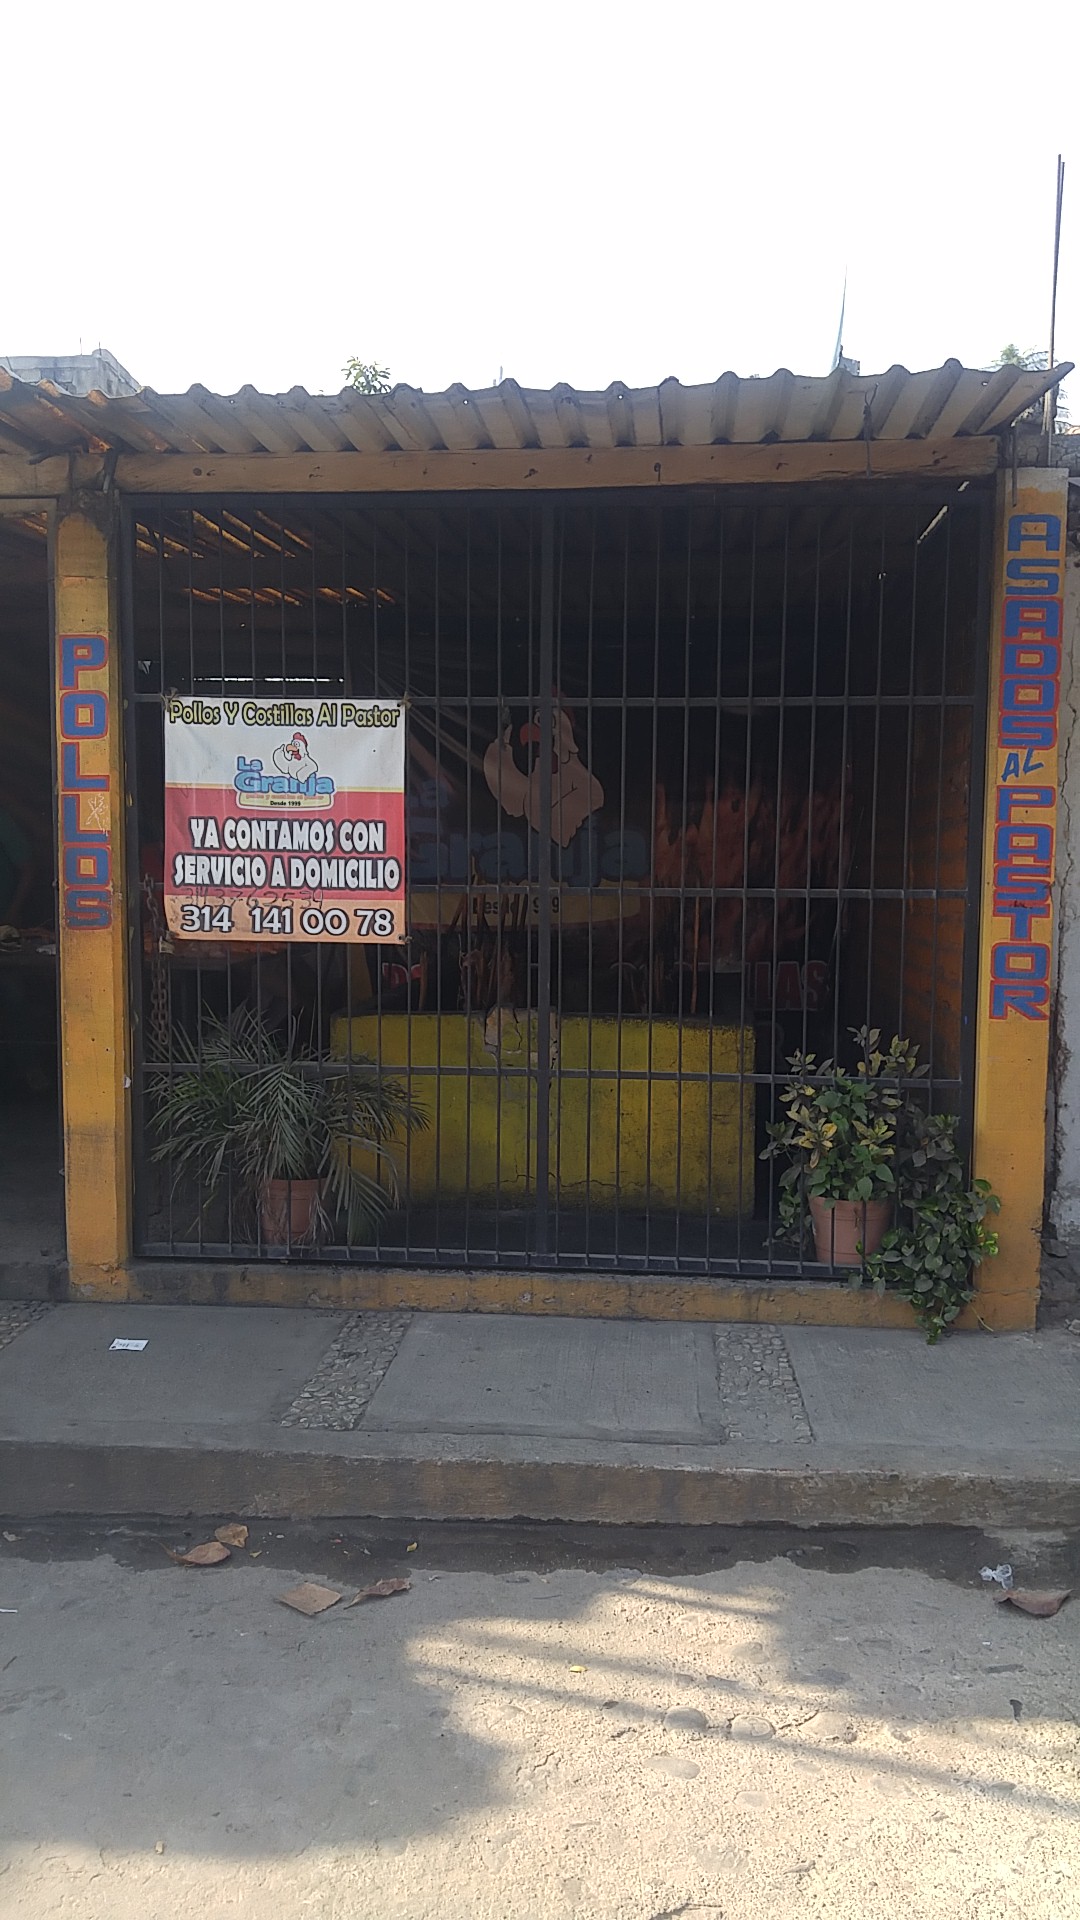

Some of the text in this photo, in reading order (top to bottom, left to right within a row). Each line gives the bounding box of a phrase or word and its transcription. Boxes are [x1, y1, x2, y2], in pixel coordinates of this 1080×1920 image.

[169, 701, 400, 728] Pollos Y Costillas Al Pastor
[237, 756, 263, 771] La
[989, 514, 1063, 1020] ASADOS AL PASTOR
[60, 634, 113, 931] POLLOS
[234, 771, 335, 796] Granja
[189, 816, 386, 853] YA CONTAMOS CON
[173, 853, 401, 891] SERVICIO A DOMICILIO
[181, 905, 394, 936] 314 141 00 78
